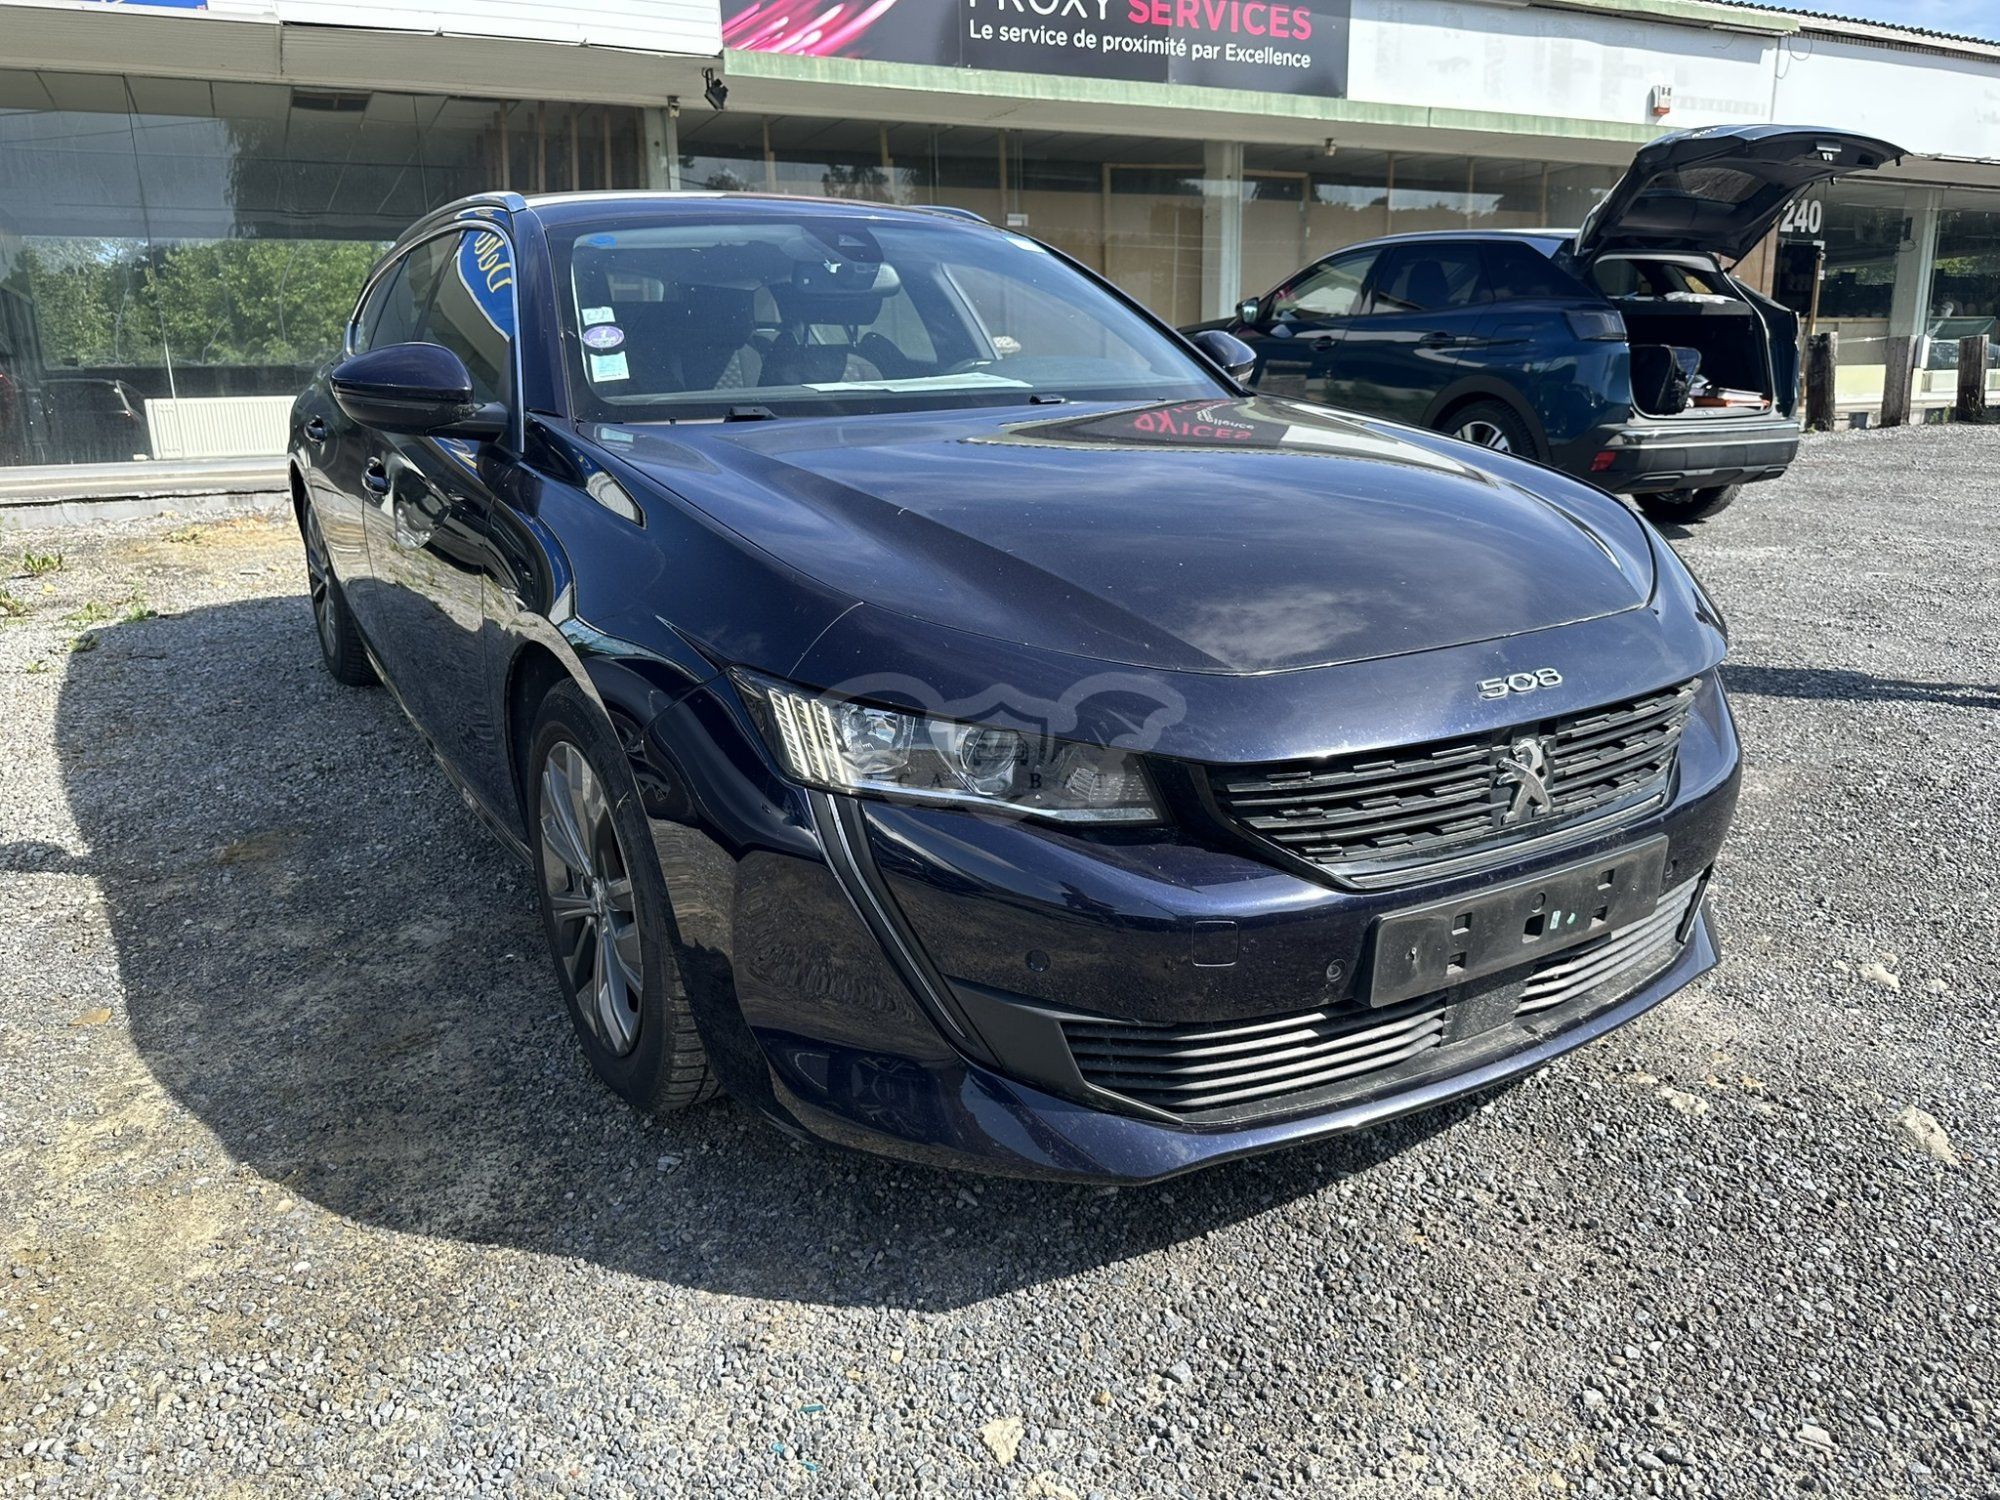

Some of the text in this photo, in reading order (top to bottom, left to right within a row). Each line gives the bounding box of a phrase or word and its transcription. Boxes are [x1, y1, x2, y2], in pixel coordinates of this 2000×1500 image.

[1127, 0, 1313, 41] SERVICES
[969, 18, 1312, 69] Le service de proximité par Excellence
[1779, 199, 1822, 234] 240
[1476, 667, 1563, 700] 508
